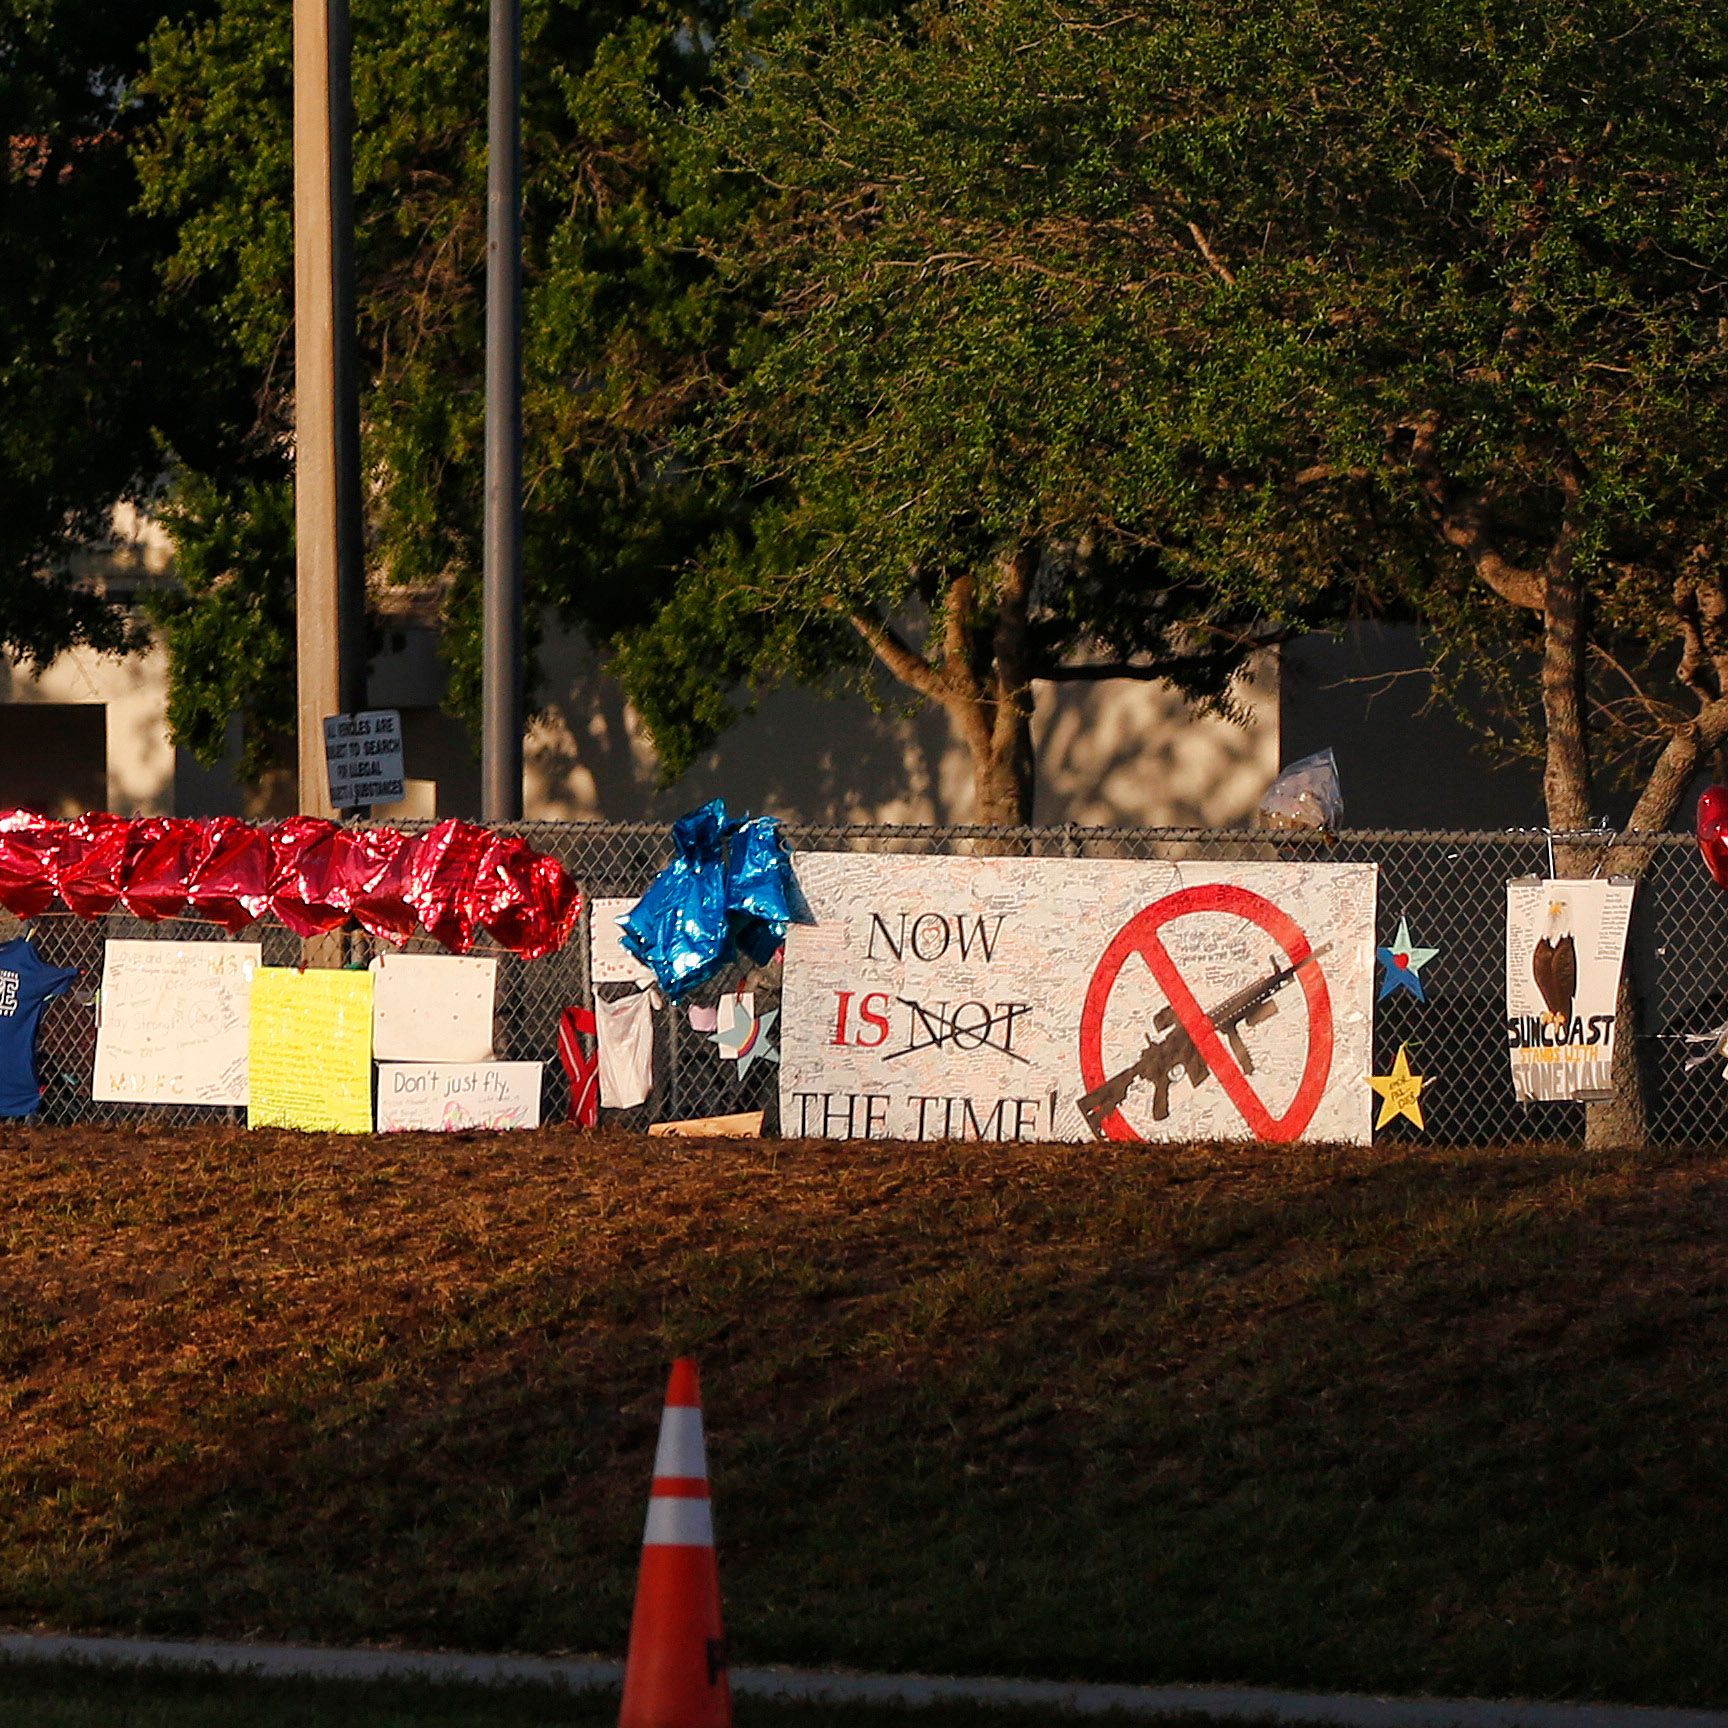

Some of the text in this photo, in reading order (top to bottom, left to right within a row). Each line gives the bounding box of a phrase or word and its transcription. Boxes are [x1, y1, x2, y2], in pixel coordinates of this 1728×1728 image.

[864, 912, 1007, 963] NOW
[830, 991, 1028, 1050] IS NOT
[1508, 1014, 1616, 1049] SUNCOAST
[1563, 1044, 1599, 1063] WITH
[394, 1070, 439, 1094] Don't
[443, 1071, 478, 1098] just
[792, 1089, 1058, 1142] THE TIME!
